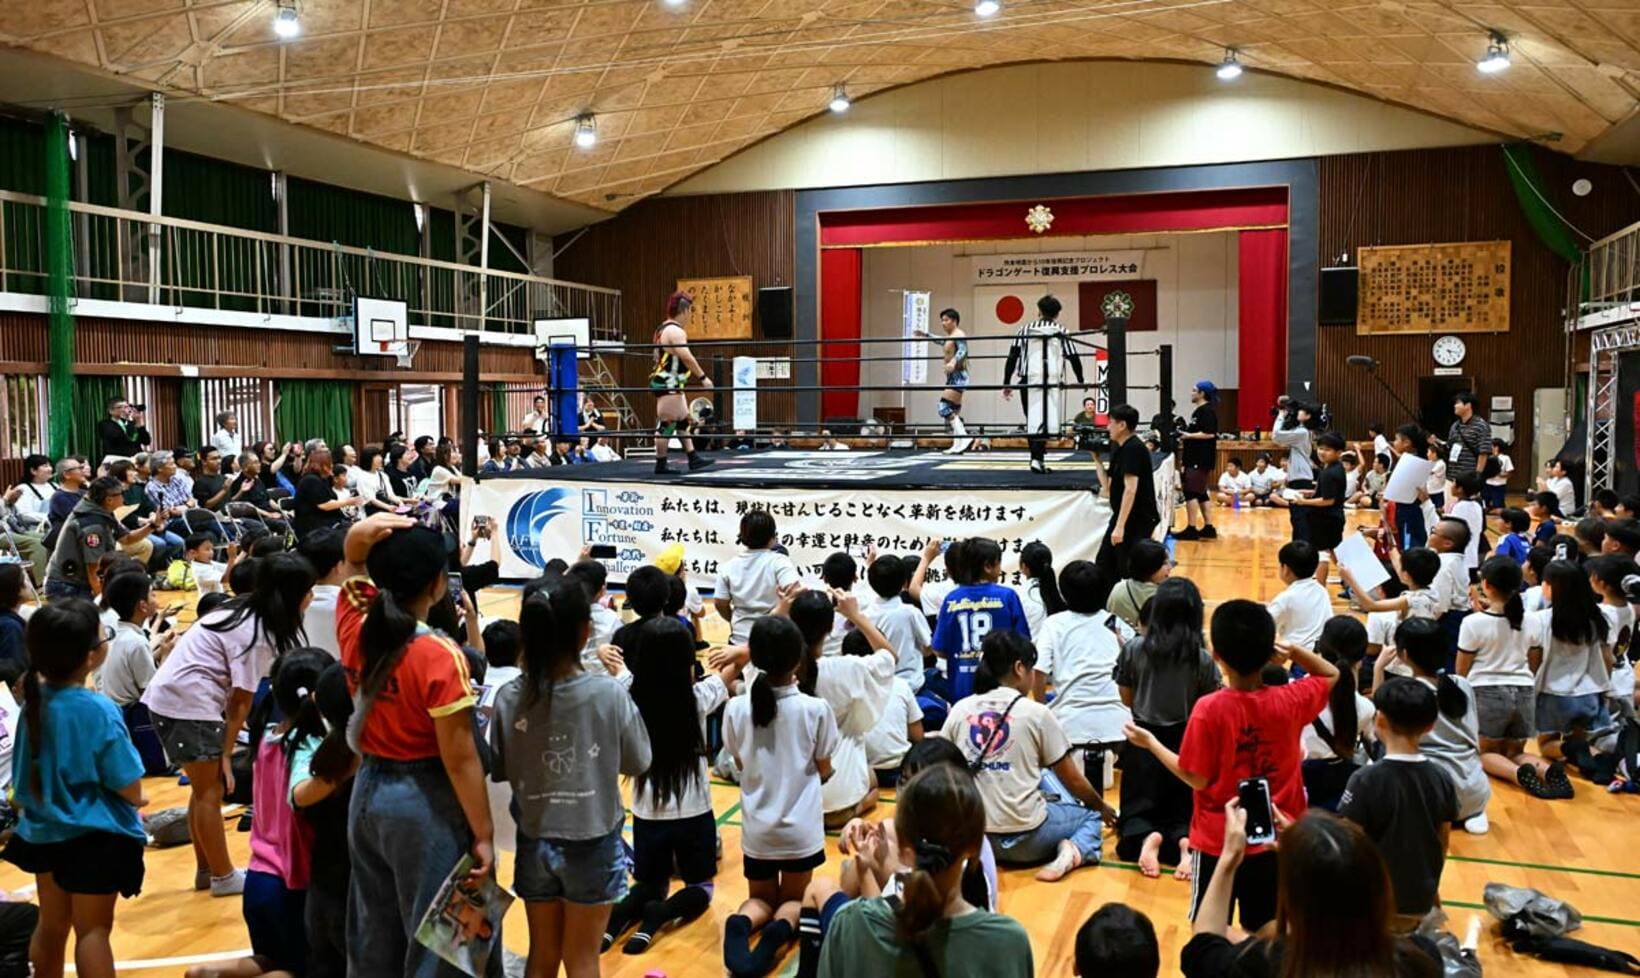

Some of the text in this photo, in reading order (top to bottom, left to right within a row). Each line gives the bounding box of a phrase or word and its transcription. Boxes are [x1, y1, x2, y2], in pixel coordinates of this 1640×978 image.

[978, 263, 1138, 278] ドラゴンゲート復興支援プロレス大会
[586, 492, 654, 516] Innovation
[586, 521, 637, 544] Fortune
[957, 612, 993, 651] 18
